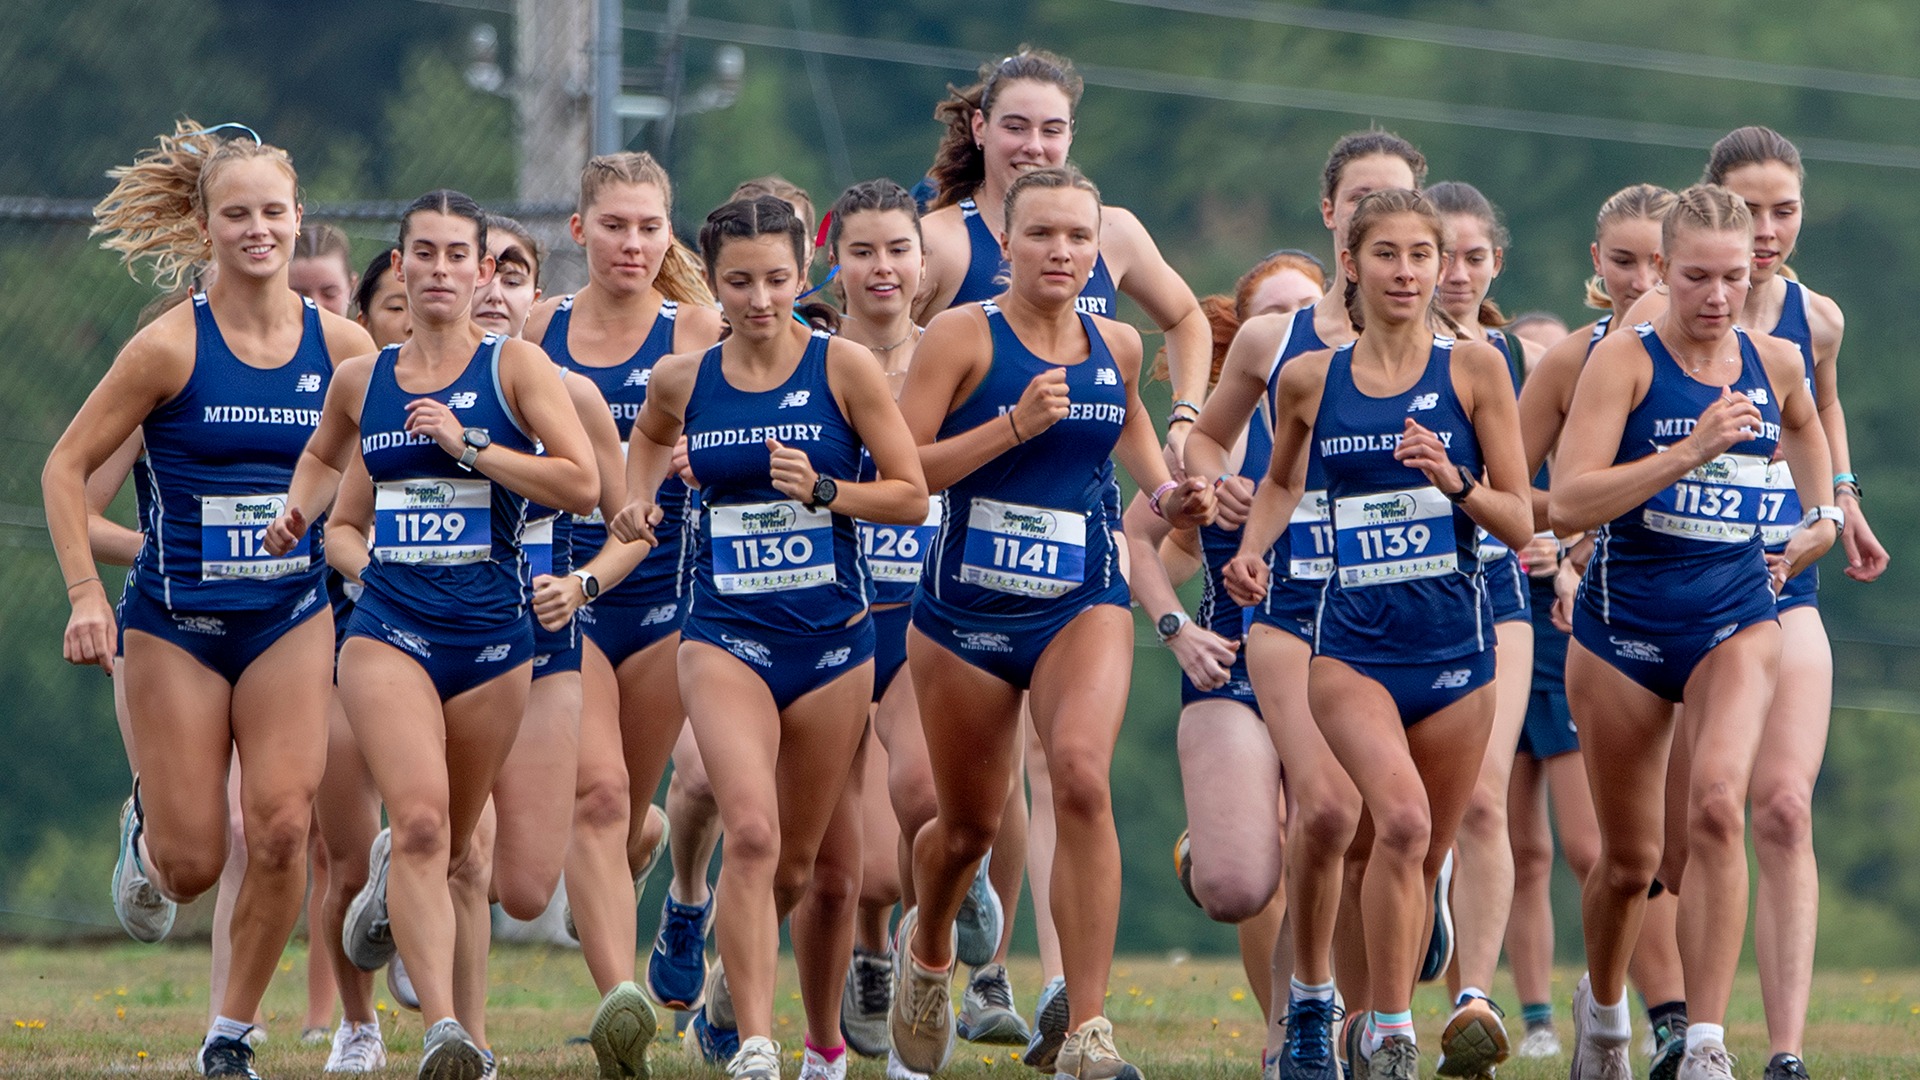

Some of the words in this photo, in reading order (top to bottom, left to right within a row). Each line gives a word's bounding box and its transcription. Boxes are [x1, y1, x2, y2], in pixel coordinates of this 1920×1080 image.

[203, 405, 324, 427] MIDDLEBUR
[691, 424, 823, 452] MIDDLEBURY
[1320, 431, 1453, 458] MIDDLEY
[235, 502, 272, 512] Second
[419, 494, 446, 503] Wind
[1363, 498, 1401, 512] Second
[1674, 482, 1743, 519] 1132
[253, 510, 277, 520] Wind
[741, 509, 780, 521] Second
[760, 517, 787, 529] Wind
[1003, 510, 1043, 525] Second
[1381, 506, 1407, 518] Wind
[395, 512, 466, 543] 1129
[1021, 522, 1048, 534] Wind
[227, 529, 272, 557] 112
[732, 535, 814, 569] 1130
[857, 527, 920, 559] 126
[1310, 525, 1335, 555] 11
[1357, 524, 1431, 560] 1139
[993, 537, 1060, 575] 1141
